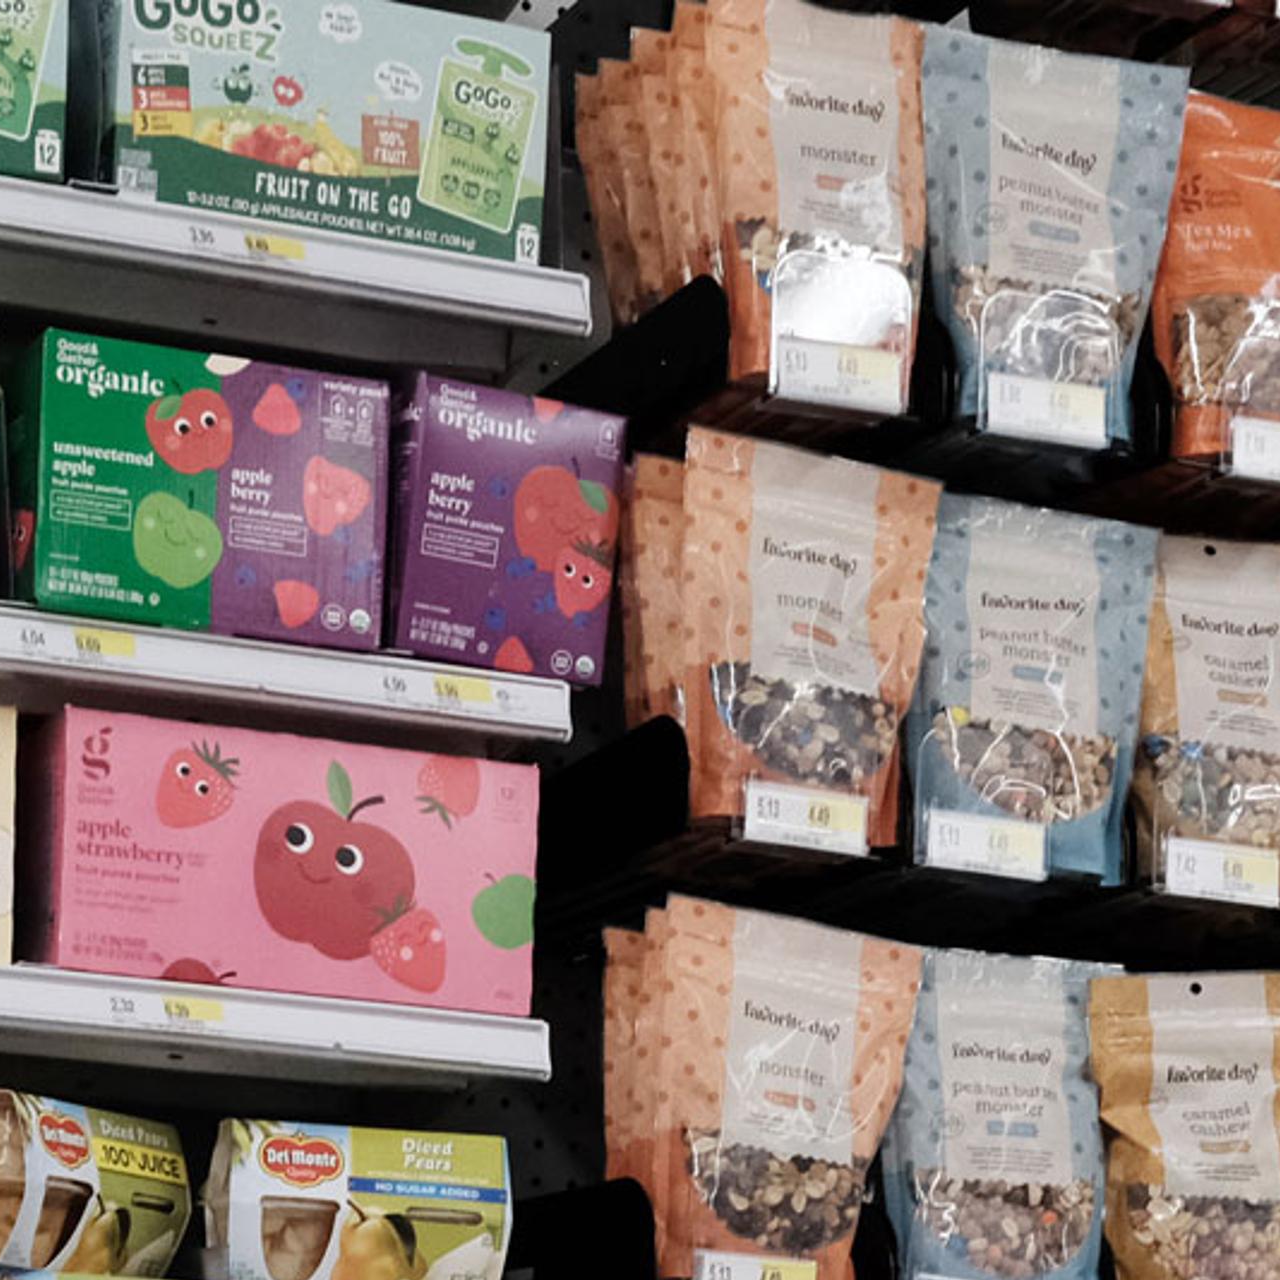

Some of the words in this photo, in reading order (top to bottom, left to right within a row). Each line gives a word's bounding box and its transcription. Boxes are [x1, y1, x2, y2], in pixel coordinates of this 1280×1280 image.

[173, 24, 278, 62] SQUEEZ
[454, 79, 513, 110] GoGo
[784, 85, 849, 115] favorite
[851, 99, 886, 122] day
[35, 142, 58, 166] 12
[373, 146, 409, 167] FRUIT
[254, 171, 308, 201] FRUIT
[317, 181, 341, 204] ON
[348, 188, 381, 214] THE
[387, 194, 412, 220] GO
[56, 365, 165, 397] organic
[438, 408, 538, 445] organic
[53, 441, 154, 467] unsweetened
[52, 458, 96, 478] apple
[231, 466, 273, 485] apple
[431, 471, 475, 491] apple
[230, 483, 272, 505] berry
[428, 491, 473, 515] berry
[762, 537, 828, 565] favorite
[830, 551, 859, 577] day
[1181, 612, 1243, 637] favorite
[1247, 621, 1280, 638] day
[1204, 654, 1270, 673] caramel
[1208, 669, 1270, 689] cashew
[76, 817, 131, 840] apple
[76, 838, 184, 867] strawberry
[744, 1000, 806, 1028] favorite
[807, 1018, 840, 1043] day
[1166, 1064, 1227, 1085] favorite
[1228, 1061, 1260, 1085] day
[402, 1136, 454, 1157] Diced
[266, 1148, 291, 1166] Del
[294, 1148, 340, 1170] Monte
[403, 1152, 453, 1173] Pears
